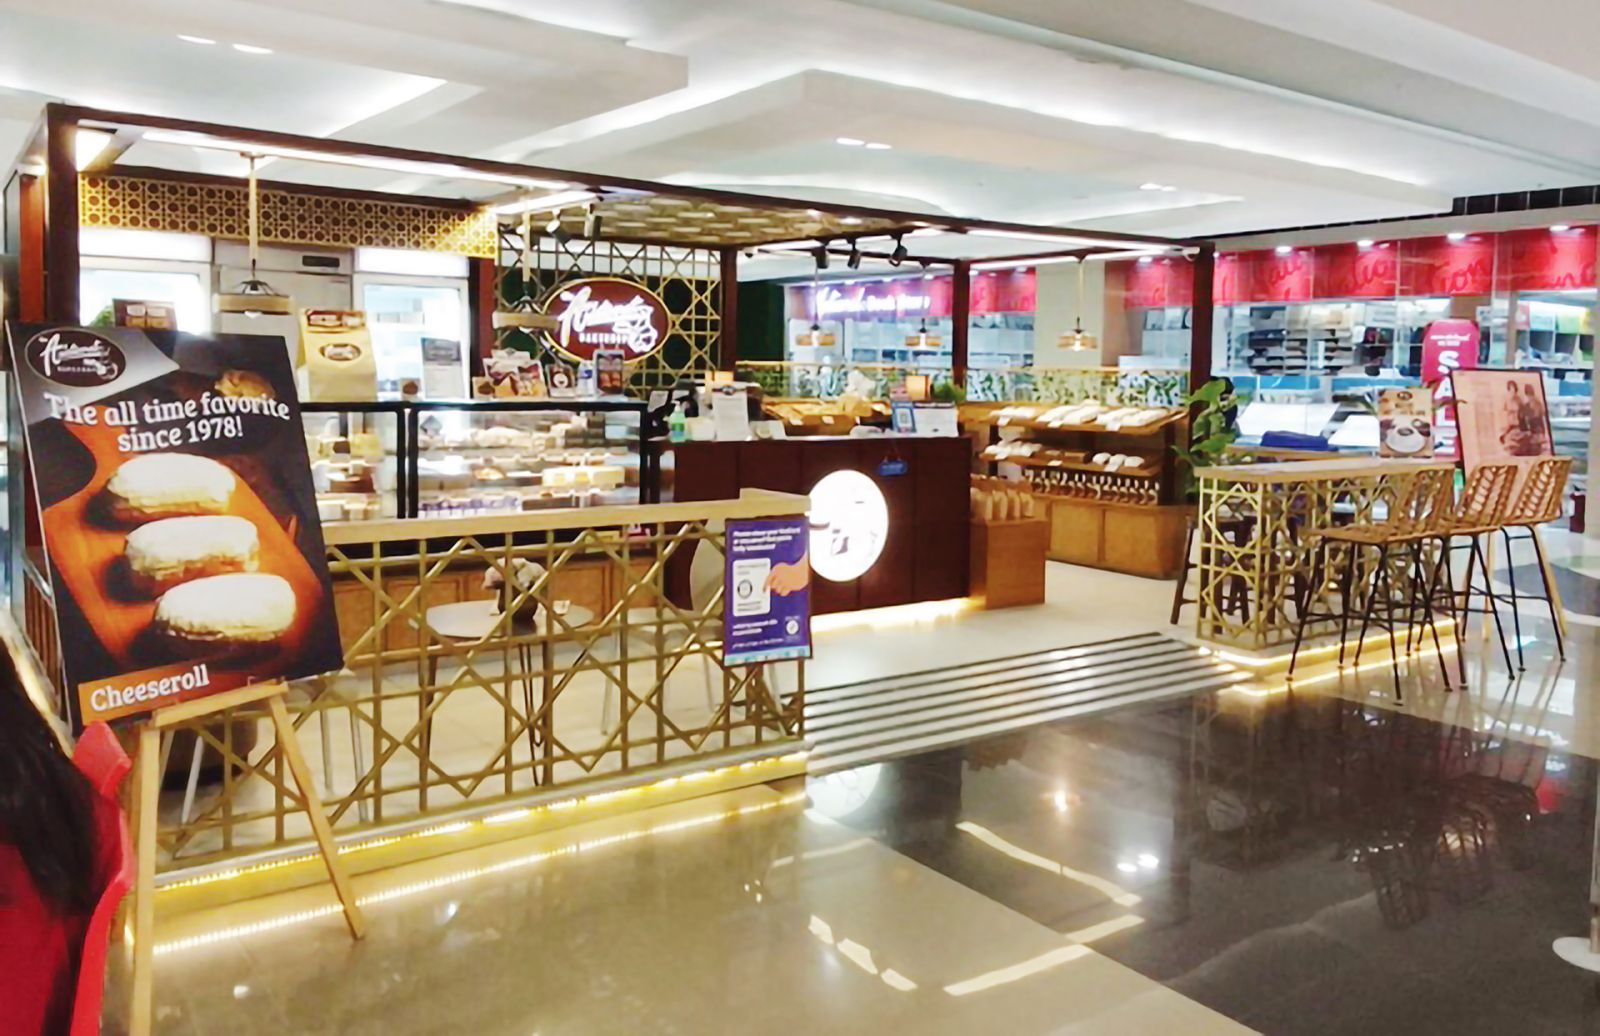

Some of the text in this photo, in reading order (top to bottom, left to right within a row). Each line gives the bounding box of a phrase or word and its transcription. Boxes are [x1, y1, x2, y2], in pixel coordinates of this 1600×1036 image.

[43, 391, 290, 427] The all time favorite
[117, 415, 244, 452] since 1978!
[90, 664, 210, 712] Cheeseroll
